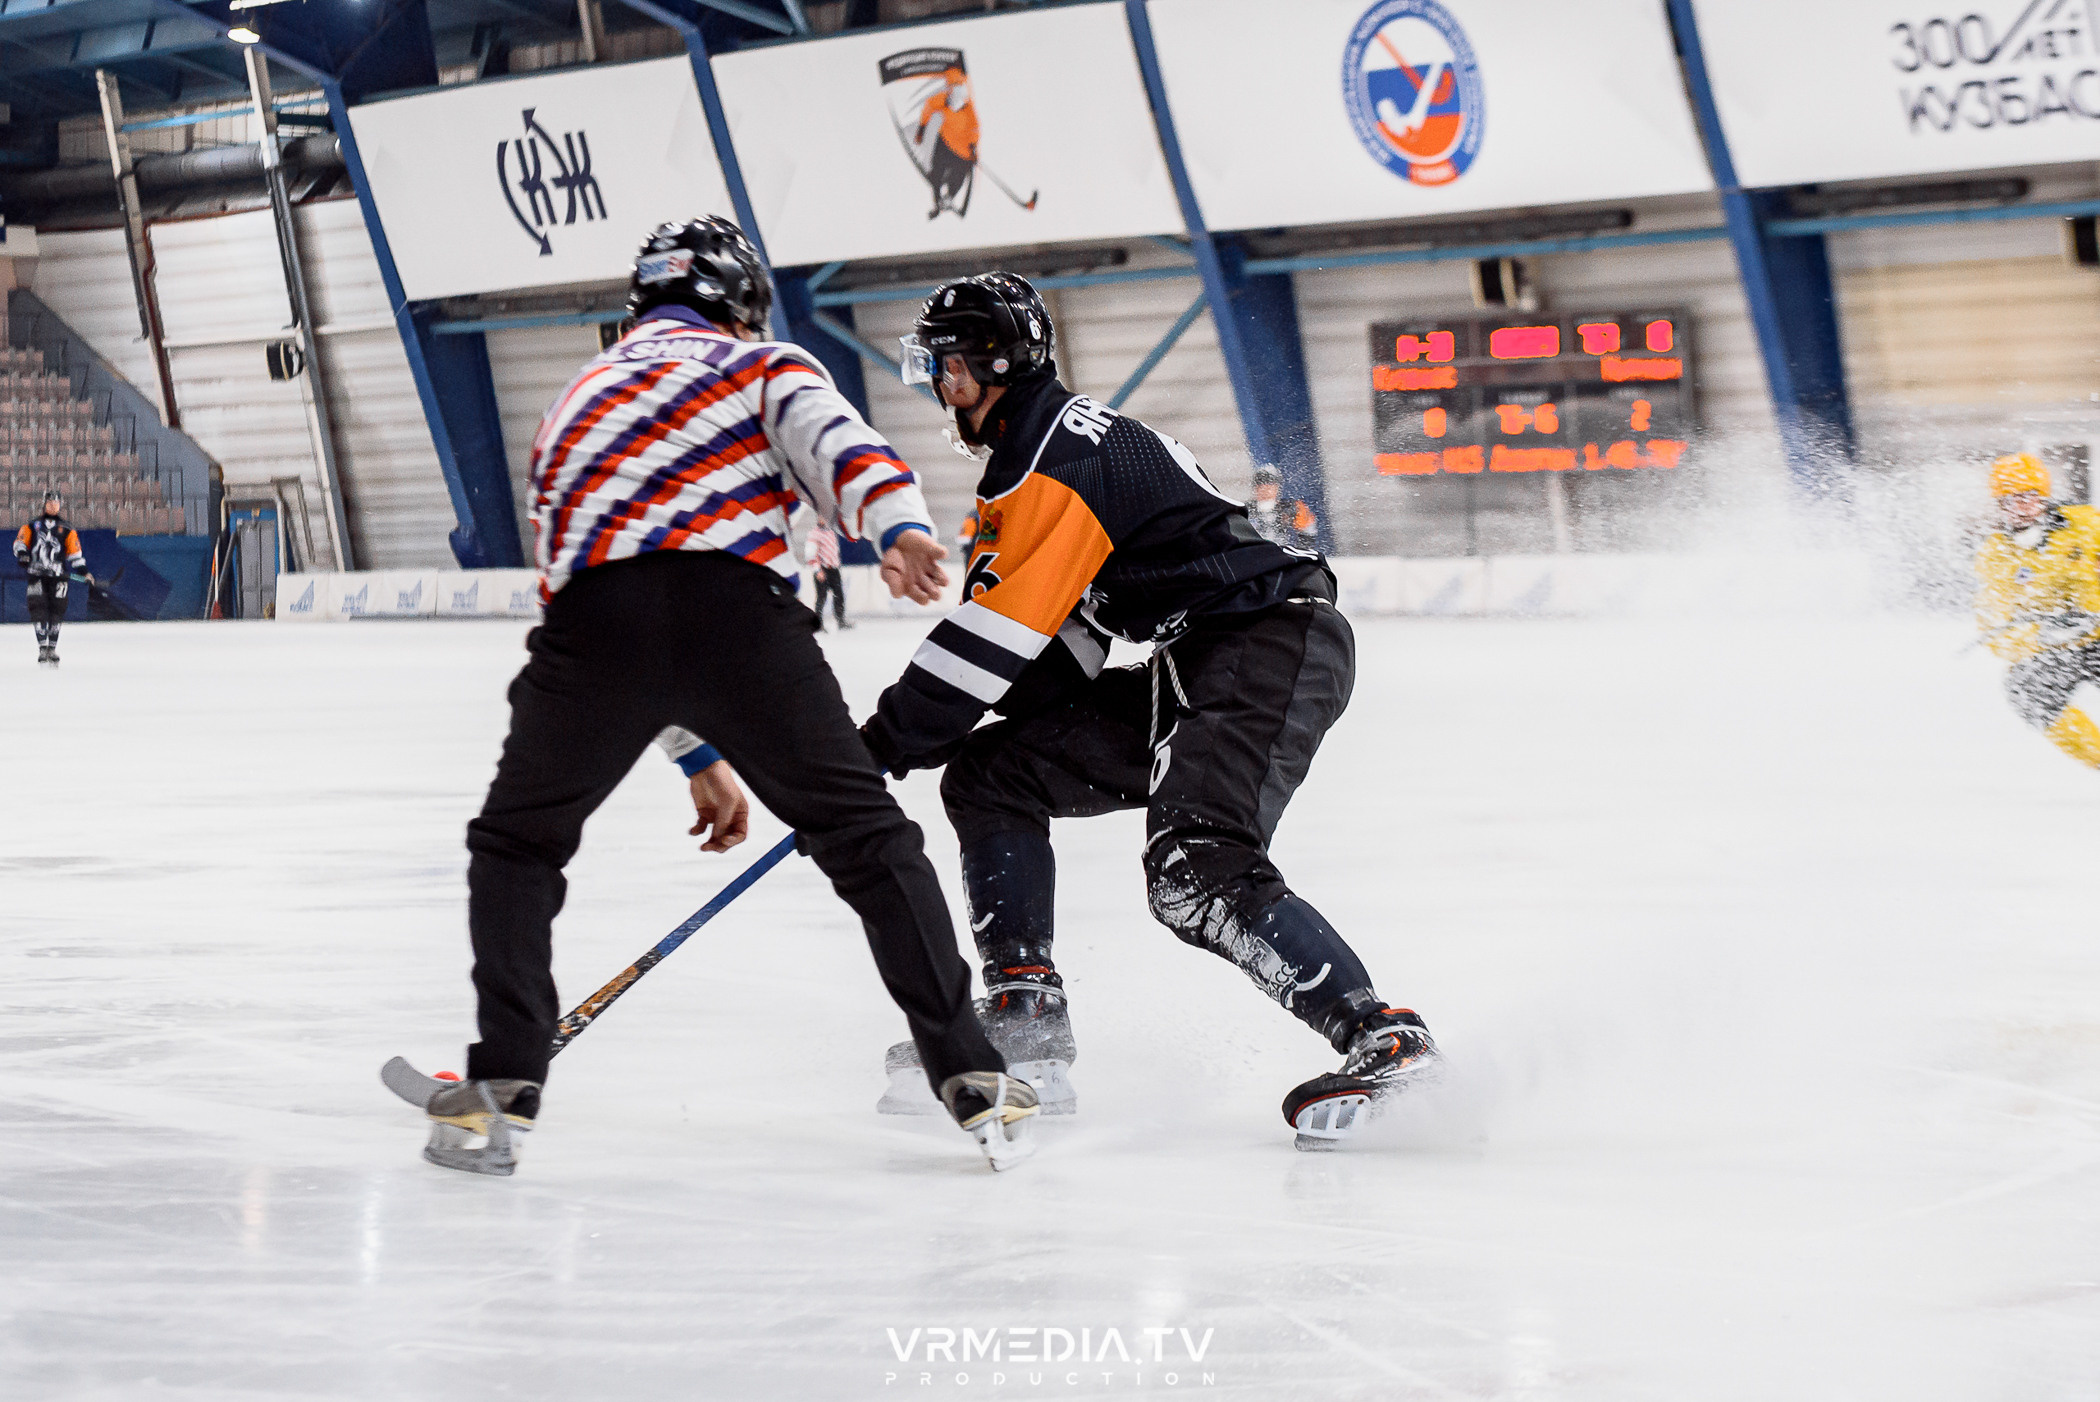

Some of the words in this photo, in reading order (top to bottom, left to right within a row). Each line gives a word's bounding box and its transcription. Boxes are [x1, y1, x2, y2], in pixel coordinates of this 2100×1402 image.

[1889, 14, 1997, 73] 300
[943, 289, 956, 308] 6
[1062, 397, 1120, 446] ЯН
[964, 552, 1003, 606] 6
